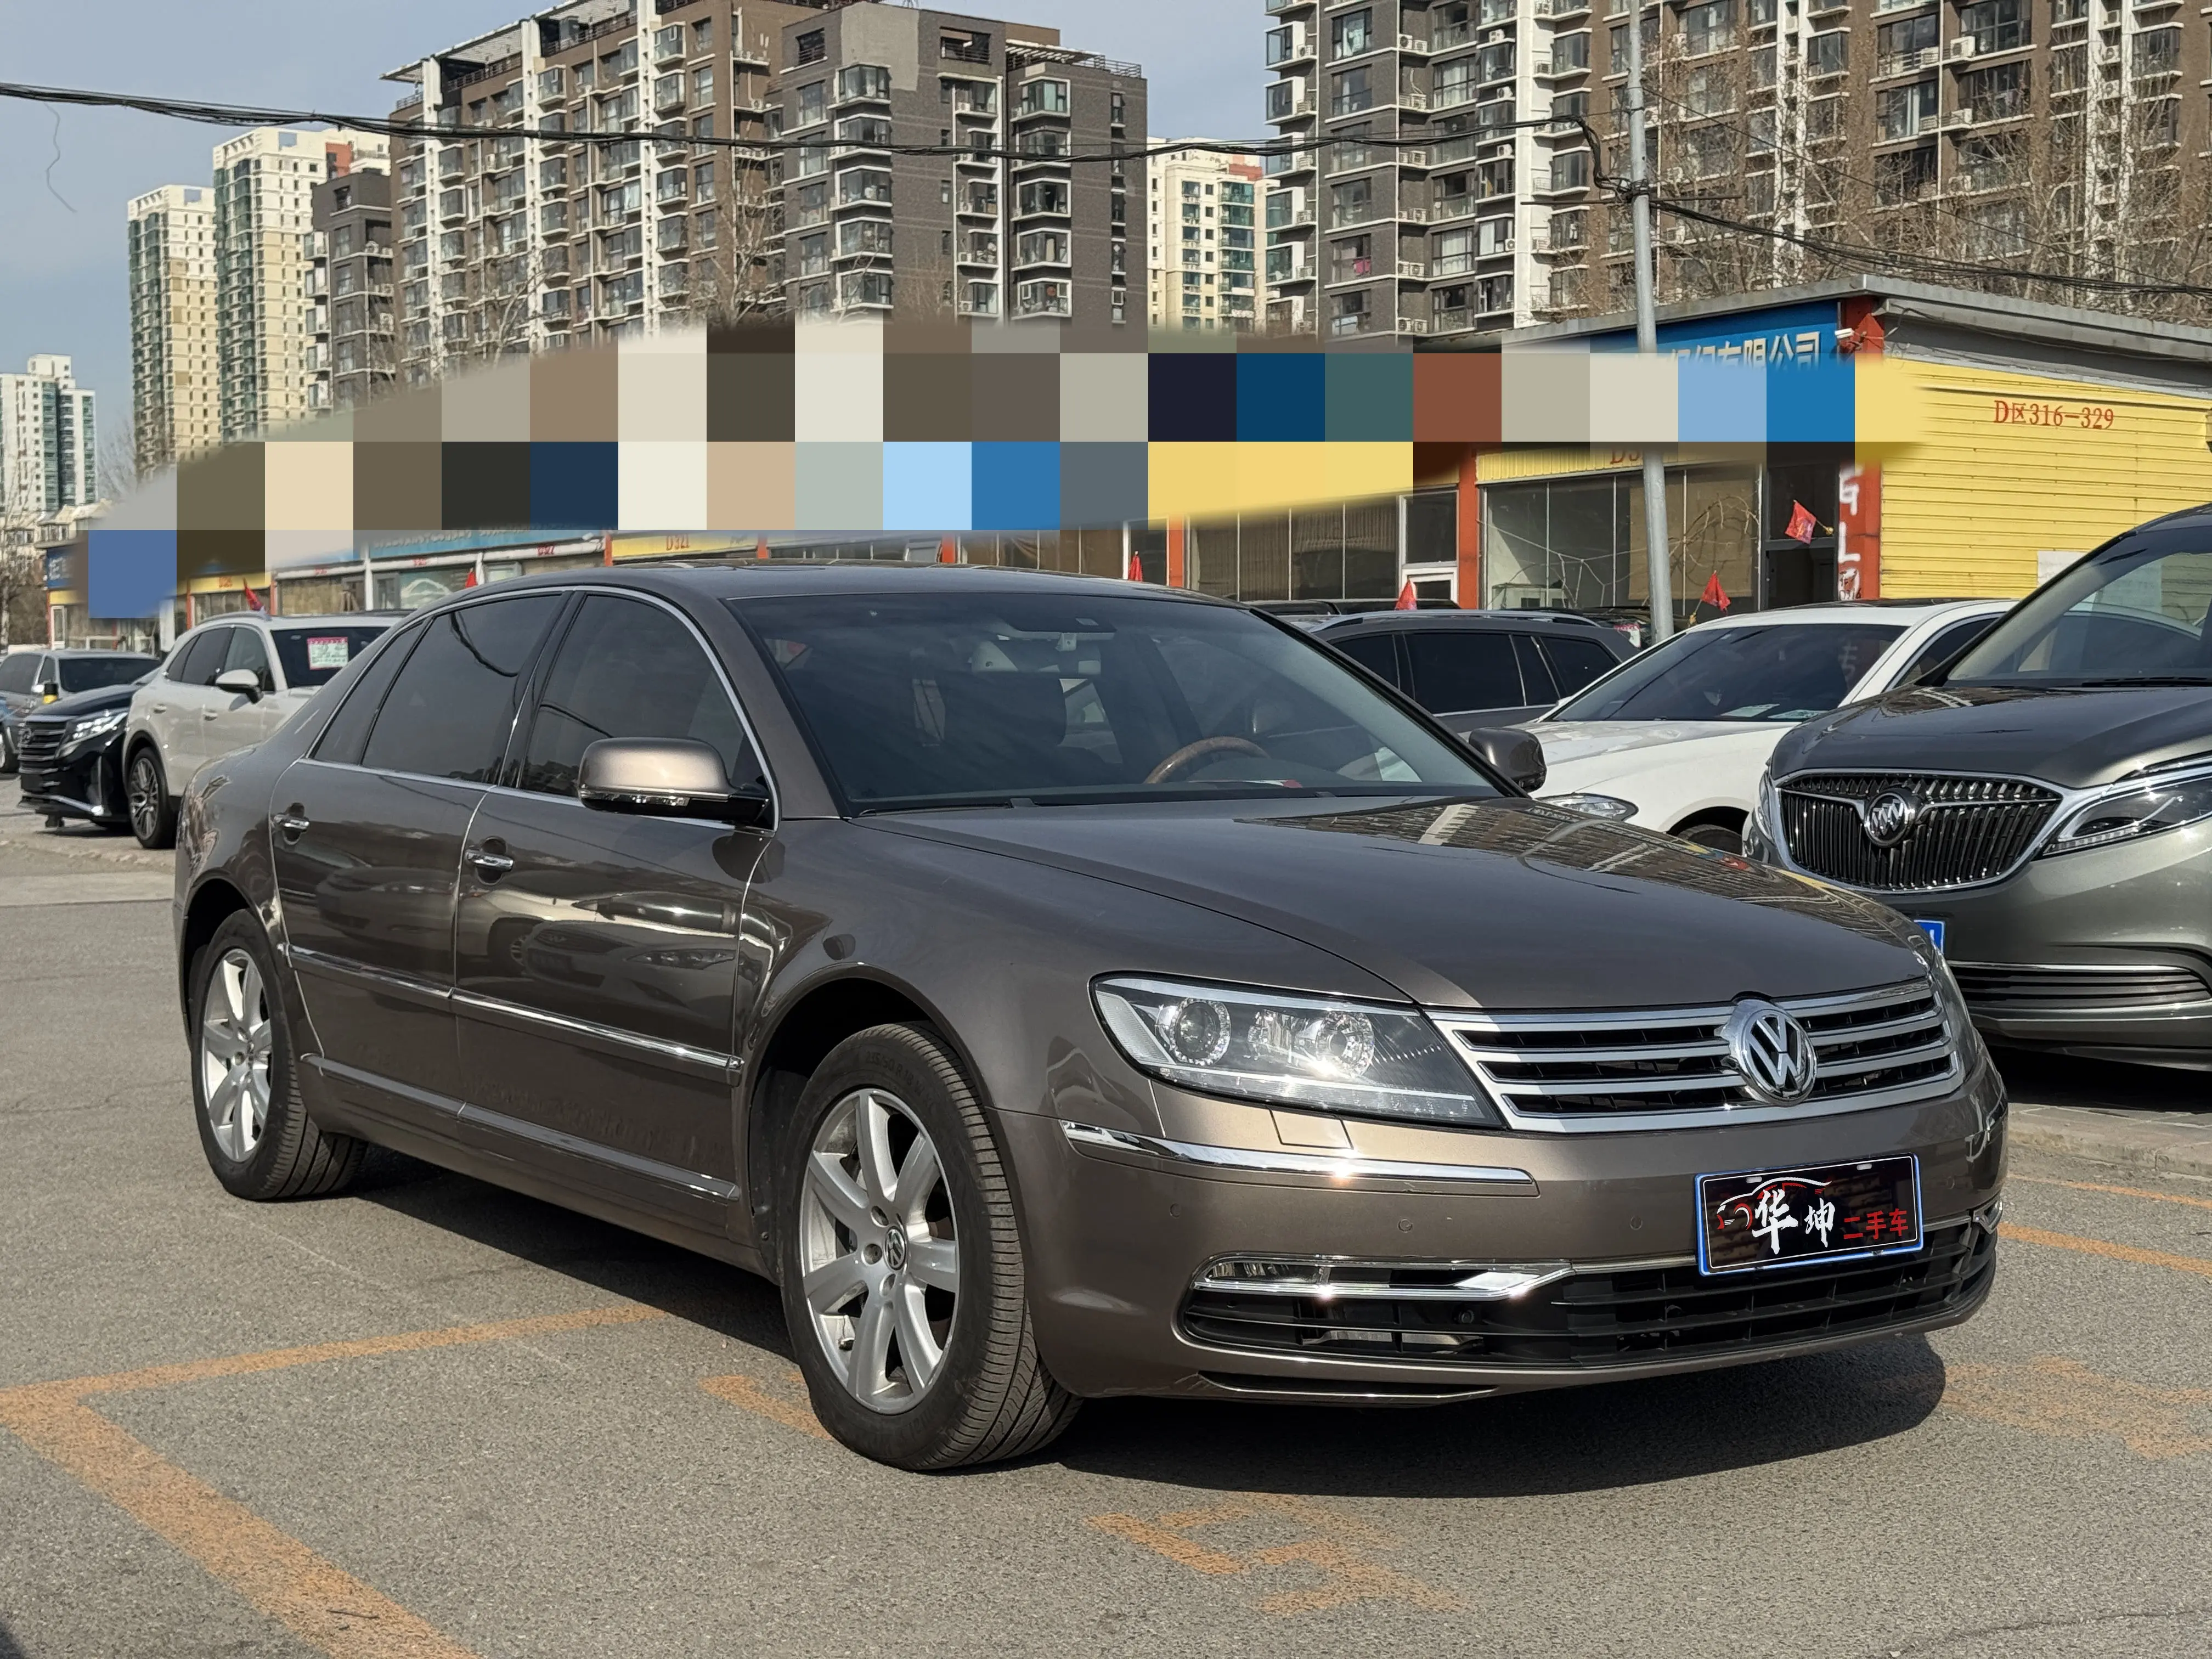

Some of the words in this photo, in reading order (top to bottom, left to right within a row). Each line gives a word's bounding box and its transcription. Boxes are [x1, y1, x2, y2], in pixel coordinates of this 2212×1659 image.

[1994, 400, 2113, 429] D区316-329
[1752, 1189, 1836, 1255] 华坤
[1843, 1208, 1908, 1240] 二手车
